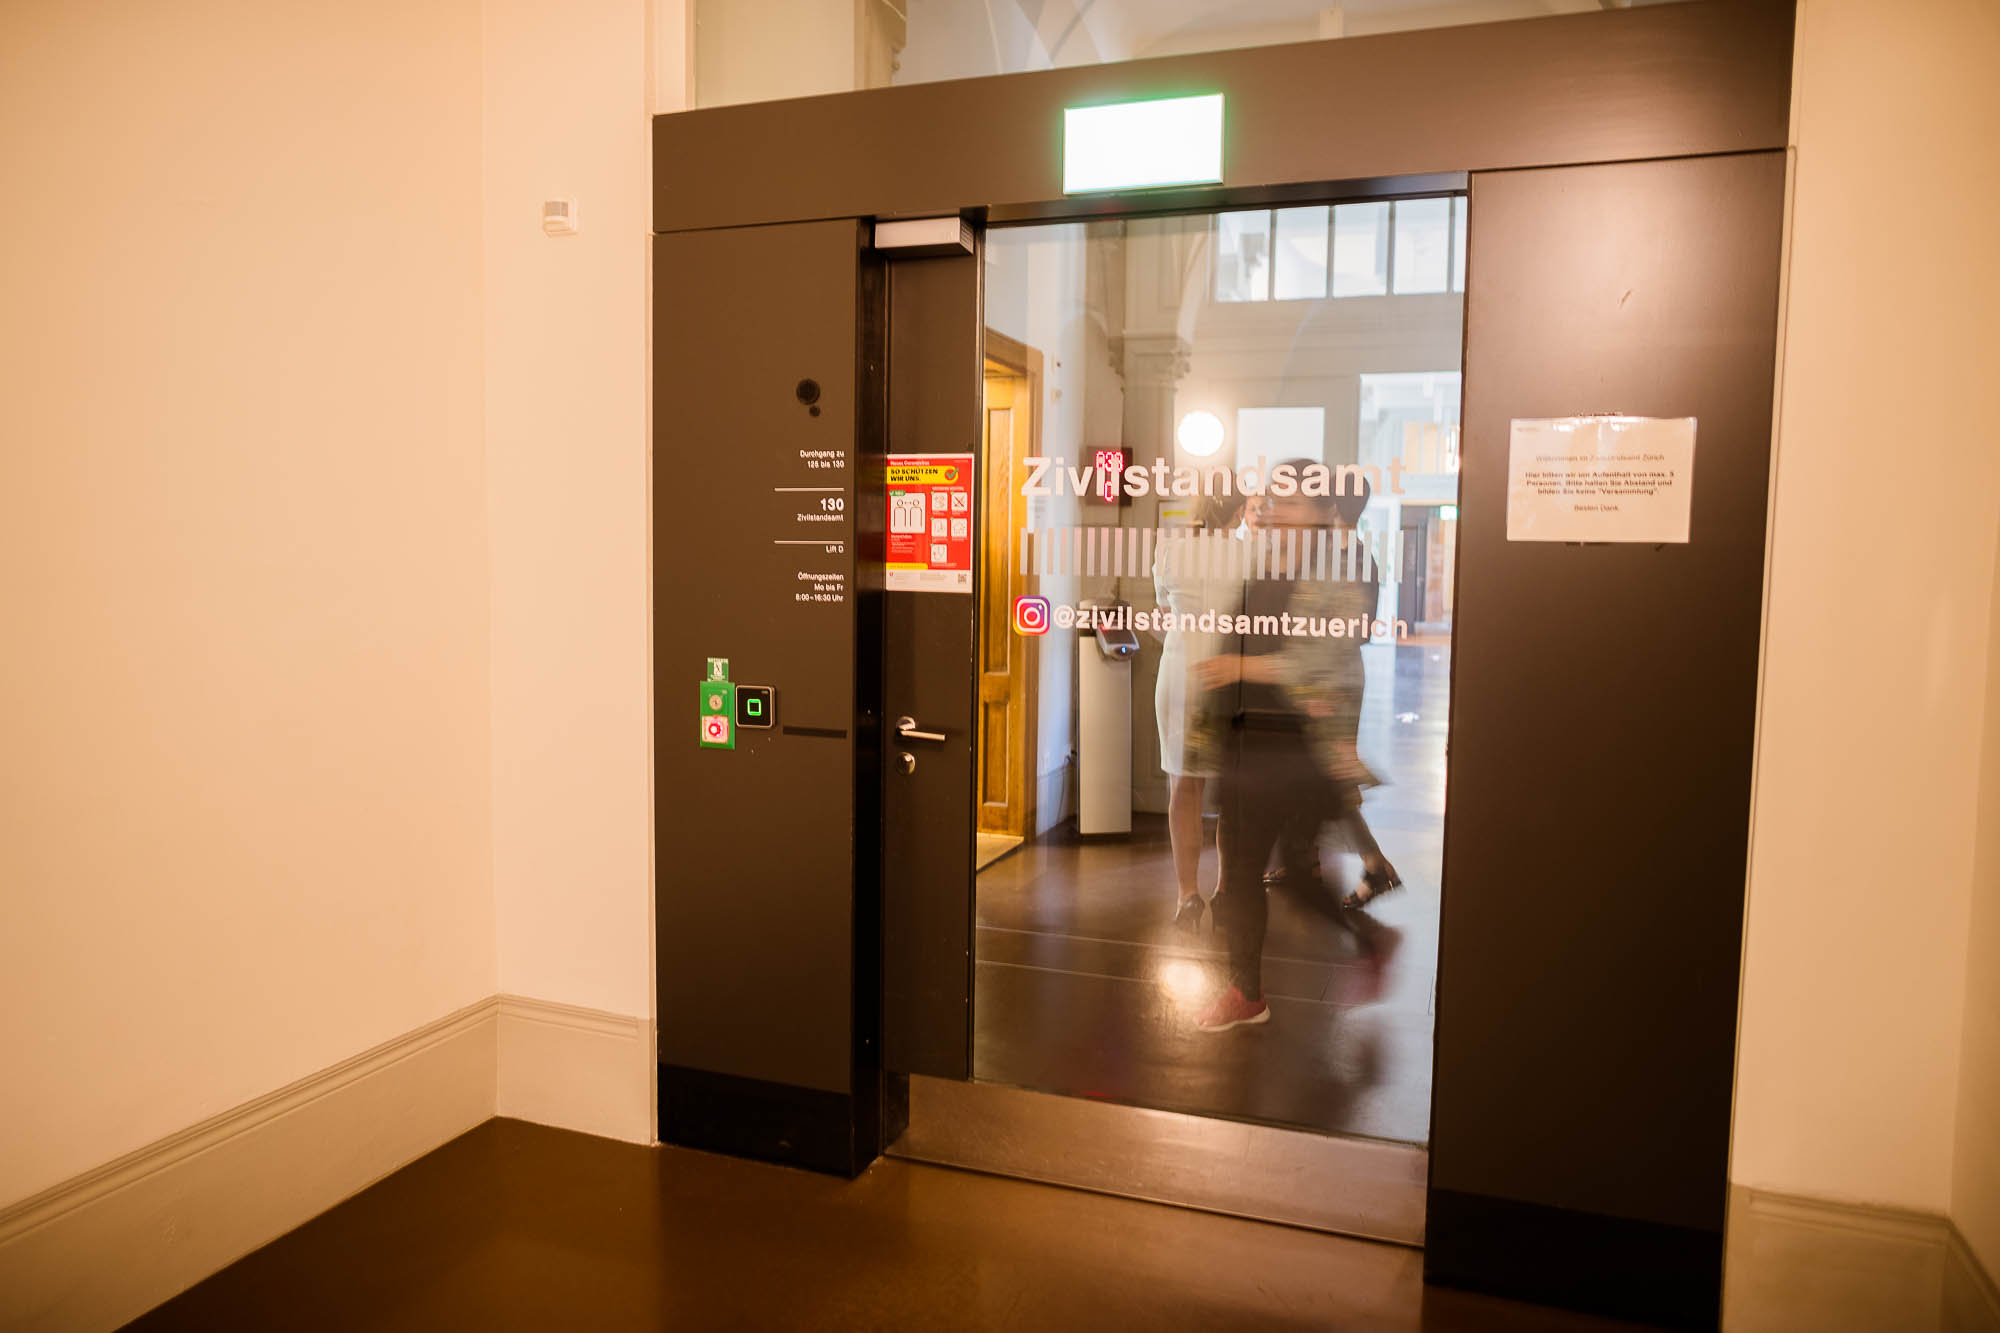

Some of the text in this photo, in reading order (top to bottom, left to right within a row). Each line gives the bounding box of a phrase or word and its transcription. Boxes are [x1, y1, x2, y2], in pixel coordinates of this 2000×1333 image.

[799, 449, 845, 459] Durchgang zu
[820, 460, 831, 469] bis
[832, 460, 845, 469] 130
[1021, 455, 1407, 498] Zivilstandsamt
[1565, 479, 1583, 487] Bitte
[1584, 479, 1608, 487] halten
[1610, 479, 1622, 487] Sie
[1623, 479, 1656, 487] Abstand
[1657, 479, 1673, 487] und
[1537, 487, 1561, 496] bilden
[1563, 487, 1574, 495] Sie
[1575, 487, 1596, 495] keine
[820, 497, 845, 511] 130
[1574, 503, 1599, 512] Besten
[797, 513, 845, 522] Zivilstandsamt
[825, 545, 844, 553] Lift D
[797, 571, 845, 582] Öffnungszeiten
[814, 583, 844, 591] Mo bis Fr
[831, 594, 844, 602] Uhr
[1053, 603, 1409, 640] @zivilstandsamtzuerich
